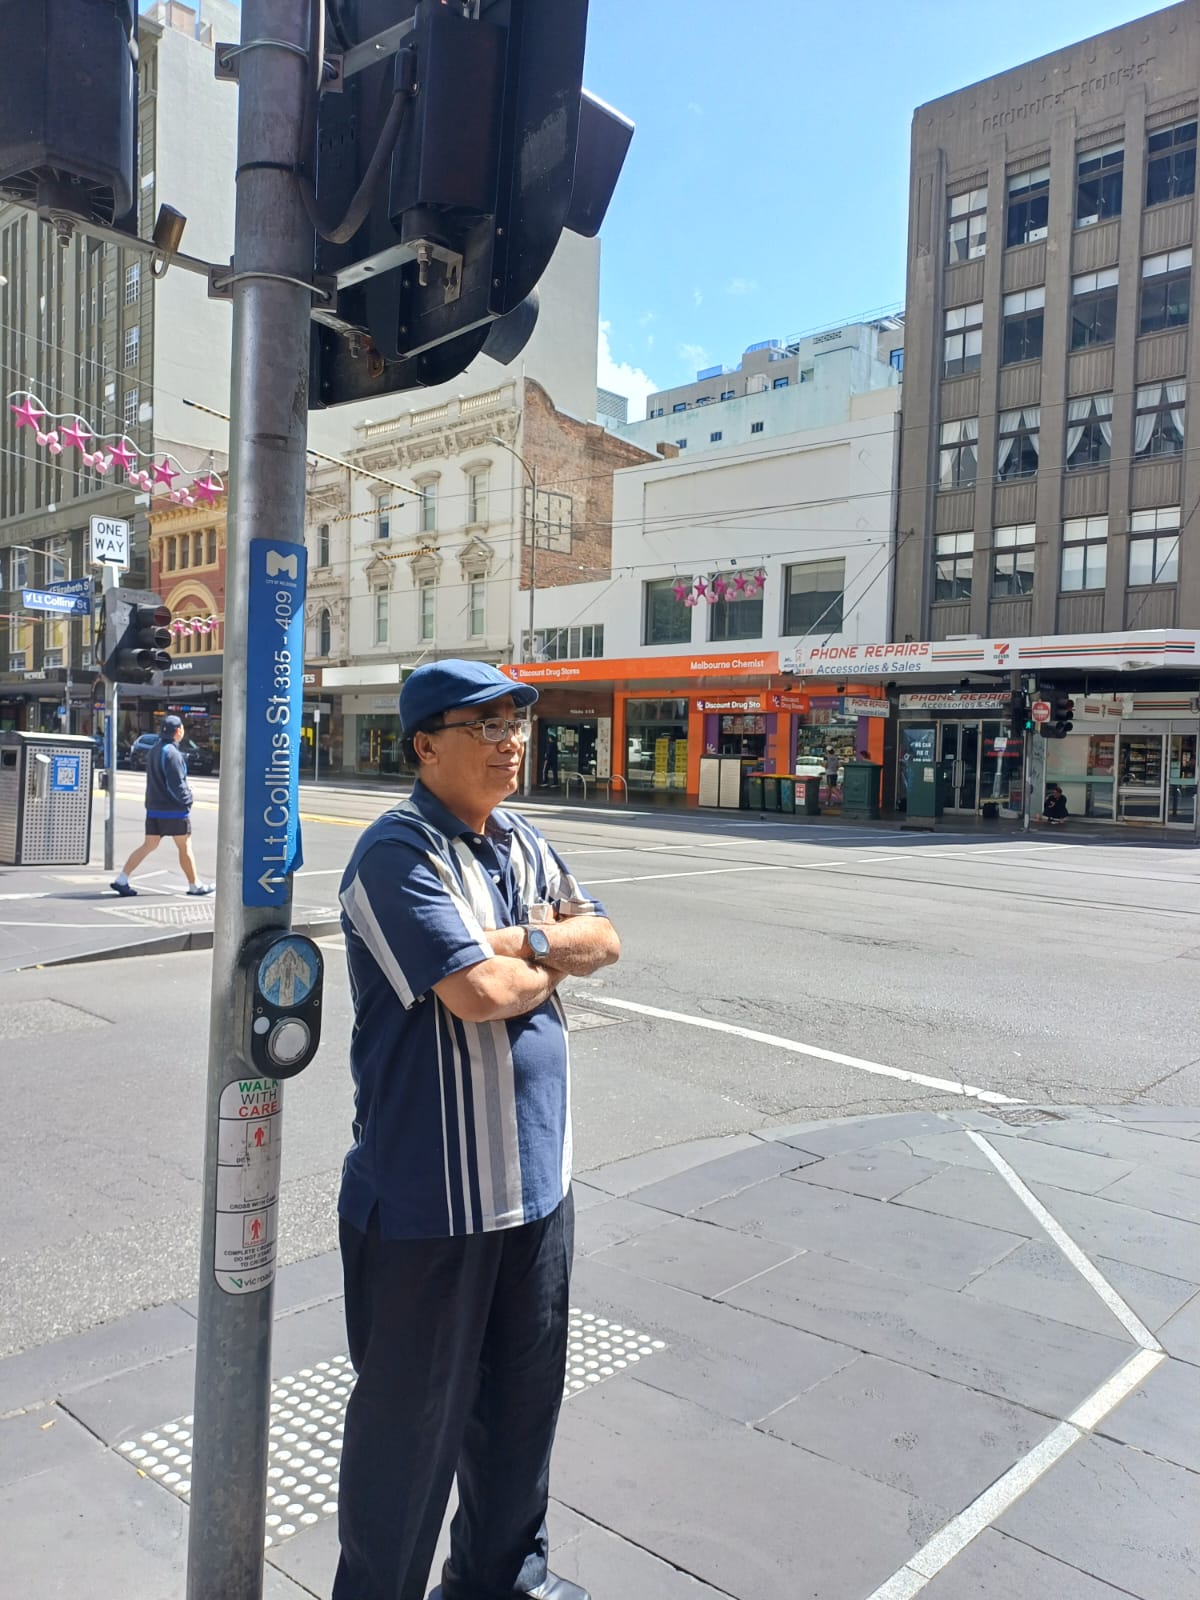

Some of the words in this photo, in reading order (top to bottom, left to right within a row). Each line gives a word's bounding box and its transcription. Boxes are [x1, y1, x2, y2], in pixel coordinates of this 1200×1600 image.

[97, 522, 122, 536] ONE
[95, 537, 124, 552] WAY
[44, 594, 75, 608] Collins
[76, 599, 87, 610] St
[274, 590, 292, 629] 409
[282, 636, 288, 645] -
[809, 646, 857, 660] PHONE
[864, 642, 931, 658] REPAIRS
[274, 650, 292, 688] 335
[690, 659, 731, 671] Melbourne
[732, 658, 765, 669] Chemist
[816, 662, 880, 674] Accessories
[881, 662, 890, 671] &
[891, 660, 921, 672] Sales
[519, 668, 545, 677] Discount
[545, 668, 560, 678] Drug
[561, 667, 580, 675] Stores
[731, 700, 748, 709] Drug
[748, 700, 760, 708] Sto
[910, 693, 955, 701] PHONE
[960, 693, 1012, 701] REPAIR
[266, 696, 291, 727] St
[263, 732, 291, 829] Collins
[262, 835, 289, 862] Lt
[238, 1079, 279, 1093] WALK
[240, 1088, 277, 1105] WITH
[238, 1100, 278, 1117] CARE
[223, 1248, 256, 1256] COMPLETE
